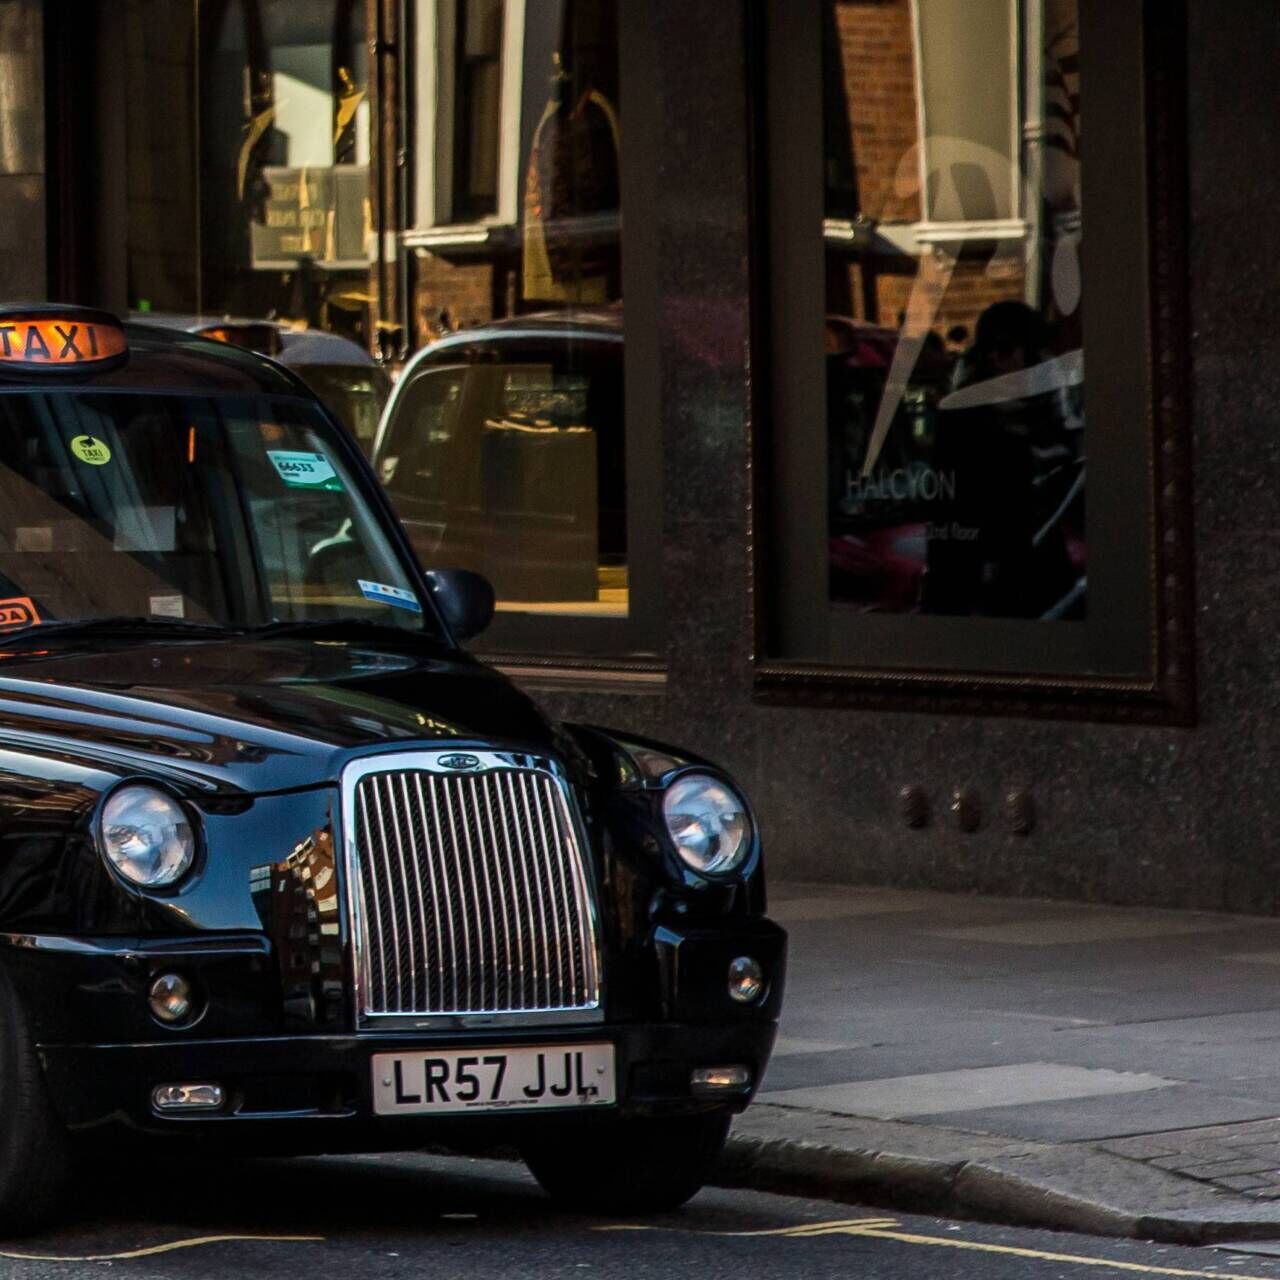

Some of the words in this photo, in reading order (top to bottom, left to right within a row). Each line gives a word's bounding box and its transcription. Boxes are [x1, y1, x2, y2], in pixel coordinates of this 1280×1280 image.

[845, 467, 956, 502] HALCYON
[393, 1054, 509, 1105] LR57
[523, 1051, 599, 1099] JJL
